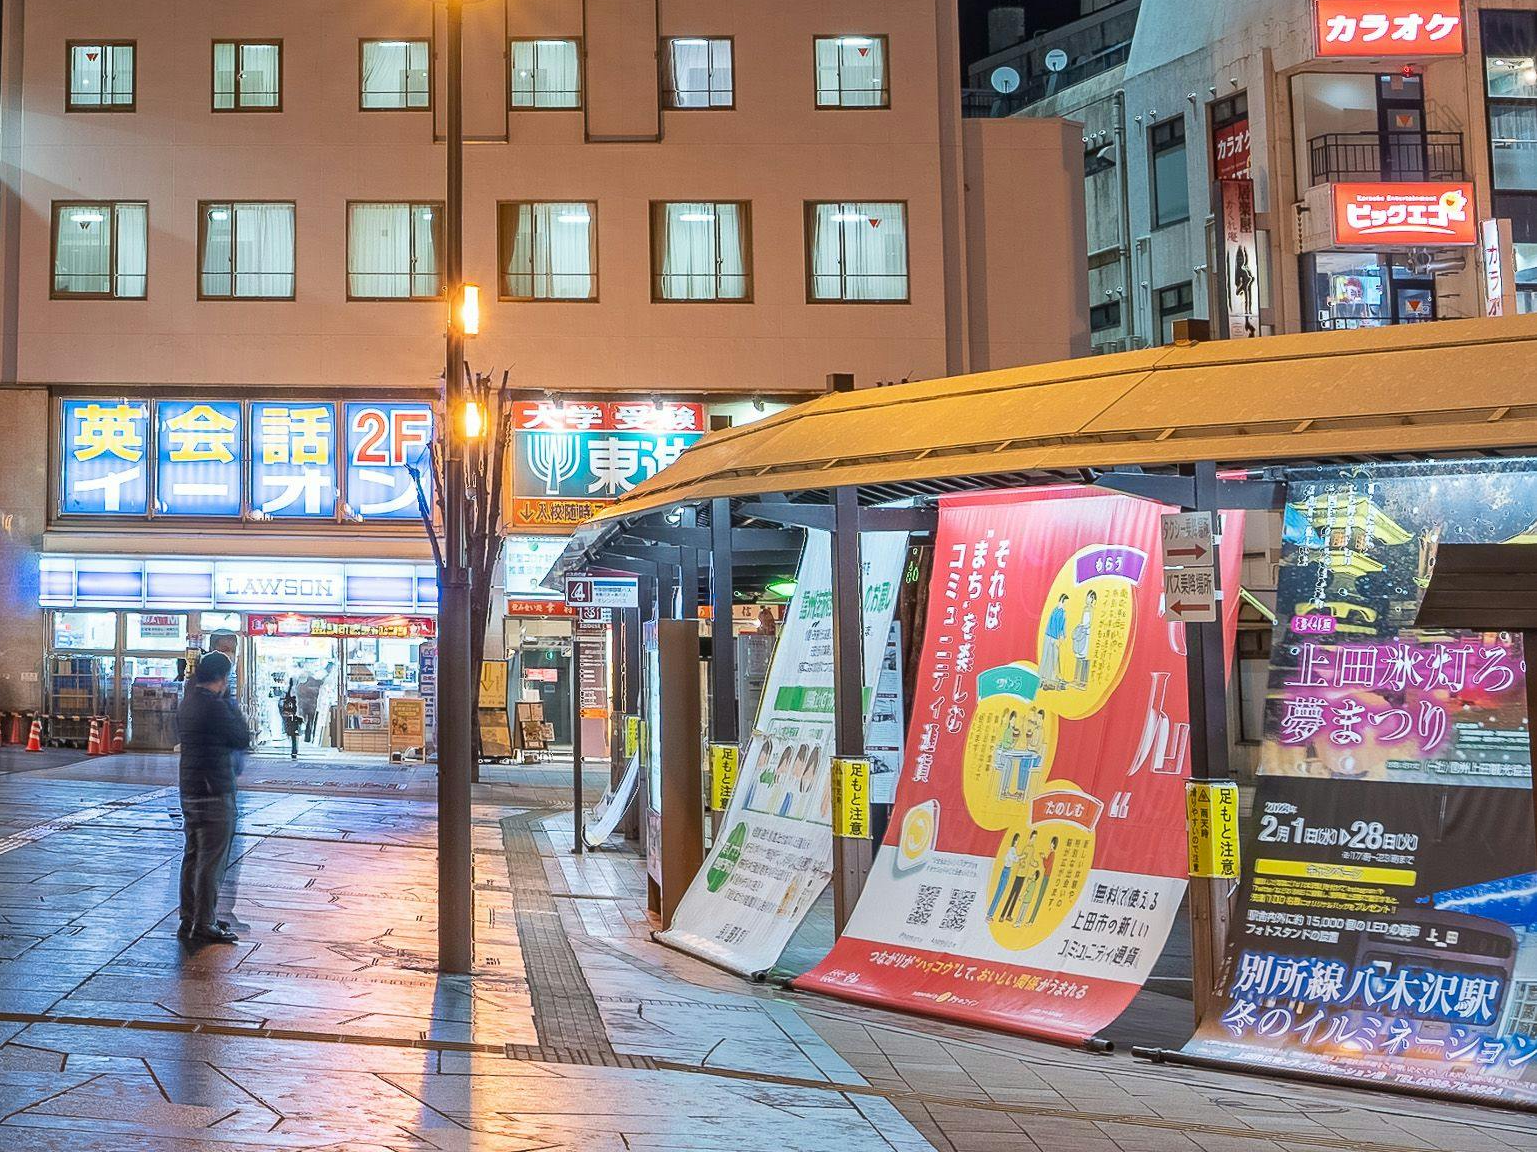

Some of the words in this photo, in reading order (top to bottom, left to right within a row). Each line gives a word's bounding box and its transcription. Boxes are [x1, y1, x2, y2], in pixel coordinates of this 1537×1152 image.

[1326, 13, 1460, 43] カラオケ
[73, 404, 331, 466] 英会話
[352, 407, 432, 467] 2F
[521, 403, 696, 430] 大学受験
[73, 466, 425, 515] イーオン
[225, 578, 334, 597] LAWSON
[571, 582, 586, 602] 4
[984, 538, 1011, 631] それは
[912, 542, 968, 784] コミュニティ通貨
[1284, 643, 1527, 693] 上田氷灯ろ
[1281, 697, 1448, 754] 夢まつり
[849, 763, 864, 836] 足もと注意
[1044, 800, 1086, 818] たのしむ
[1219, 788, 1235, 876] 足もと注意
[1093, 882, 1160, 911] 無料で使える
[1071, 910, 1151, 939] 上田市の新しい
[1057, 938, 1142, 968] コミュニティ通貨
[1233, 952, 1499, 1021] 別所線八木沢駅
[1221, 998, 1537, 1068] 冬のイルミネーション
